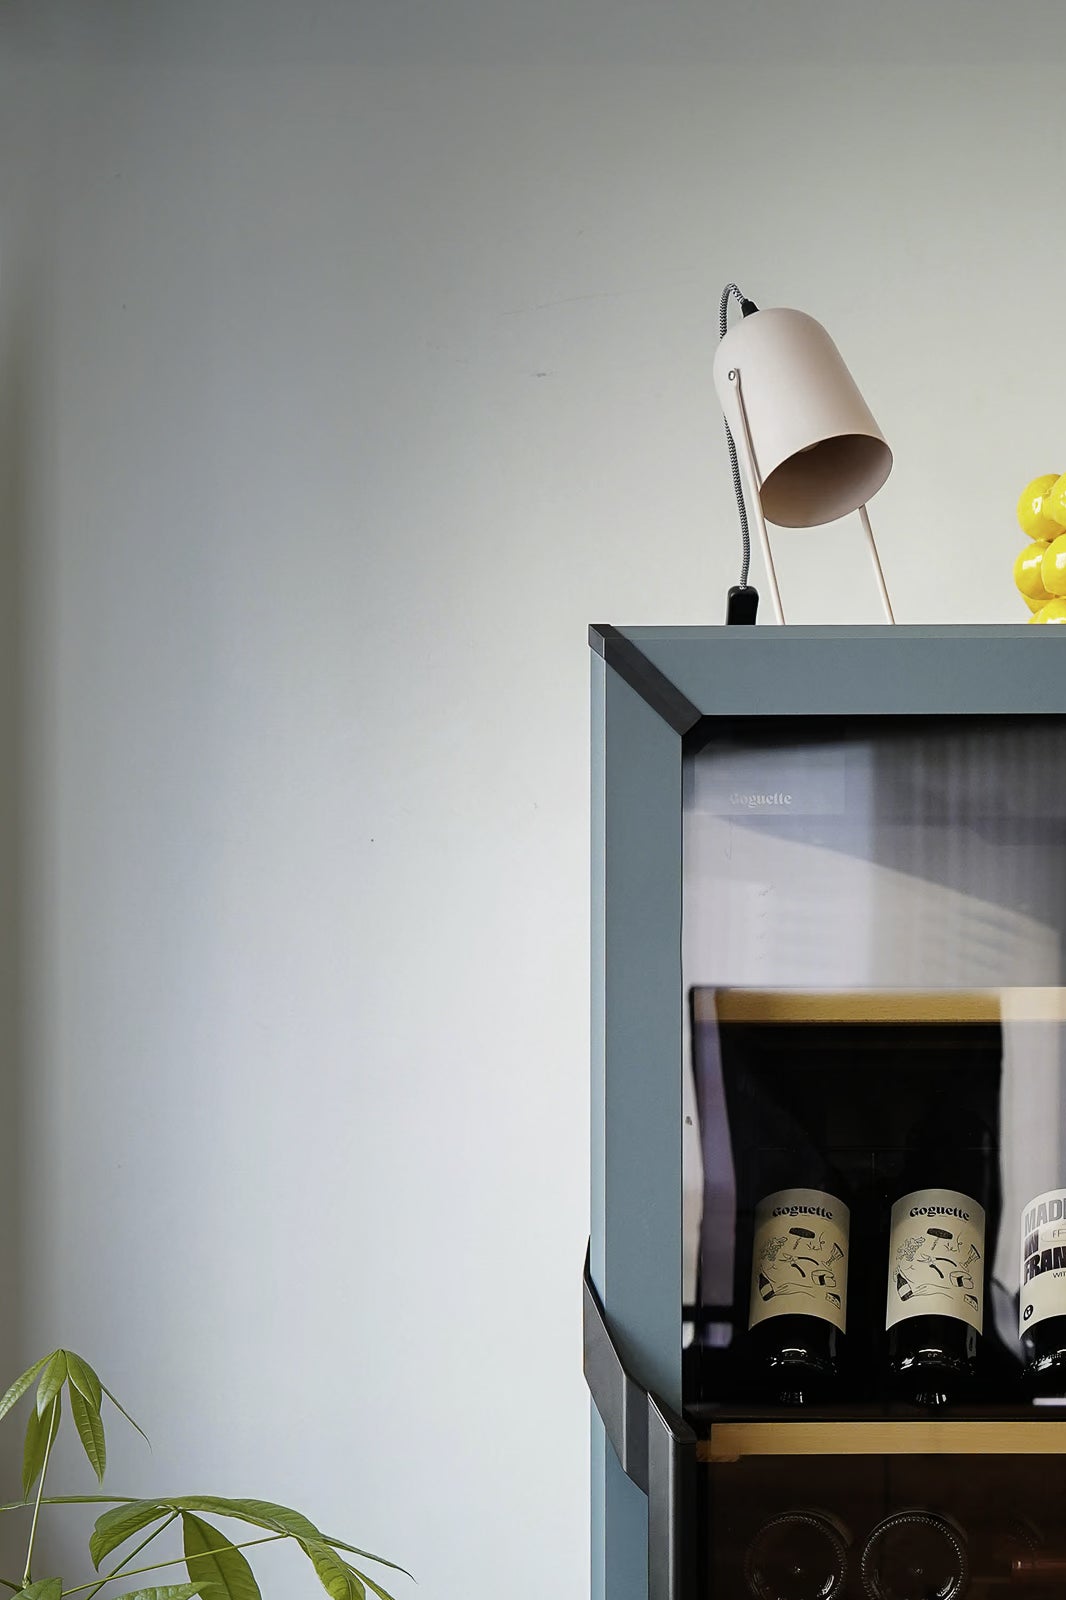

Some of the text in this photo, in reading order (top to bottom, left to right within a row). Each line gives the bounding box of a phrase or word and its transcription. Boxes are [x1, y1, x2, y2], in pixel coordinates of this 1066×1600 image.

[772, 1205, 833, 1220] Goguette
[909, 1206, 970, 1221] Goguette
[1024, 1230, 1039, 1262] IN
